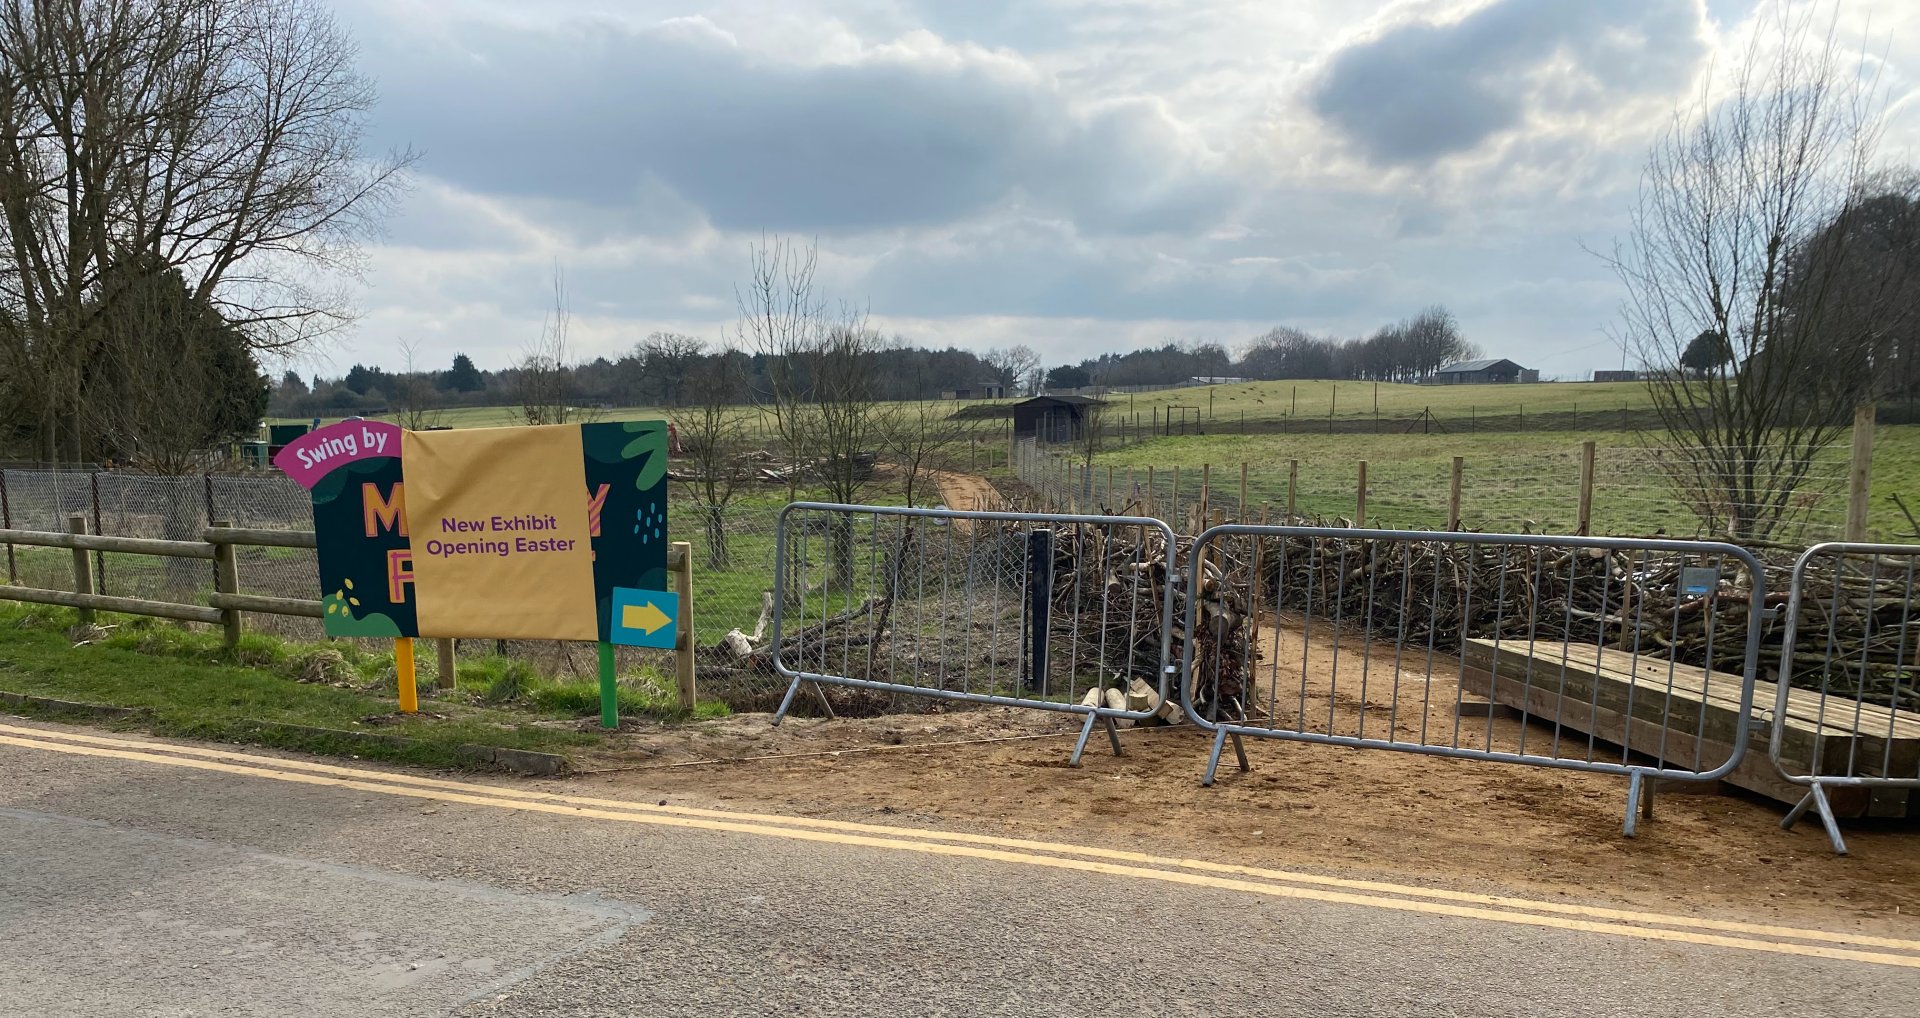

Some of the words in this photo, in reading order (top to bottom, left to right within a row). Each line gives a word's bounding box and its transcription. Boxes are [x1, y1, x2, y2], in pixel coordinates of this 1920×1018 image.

[297, 434, 356, 469] Swing
[362, 427, 388, 453] by
[441, 517, 485, 533] New
[491, 515, 557, 532] Exhibit
[426, 538, 509, 557] Opening
[515, 537, 576, 553] Easter
